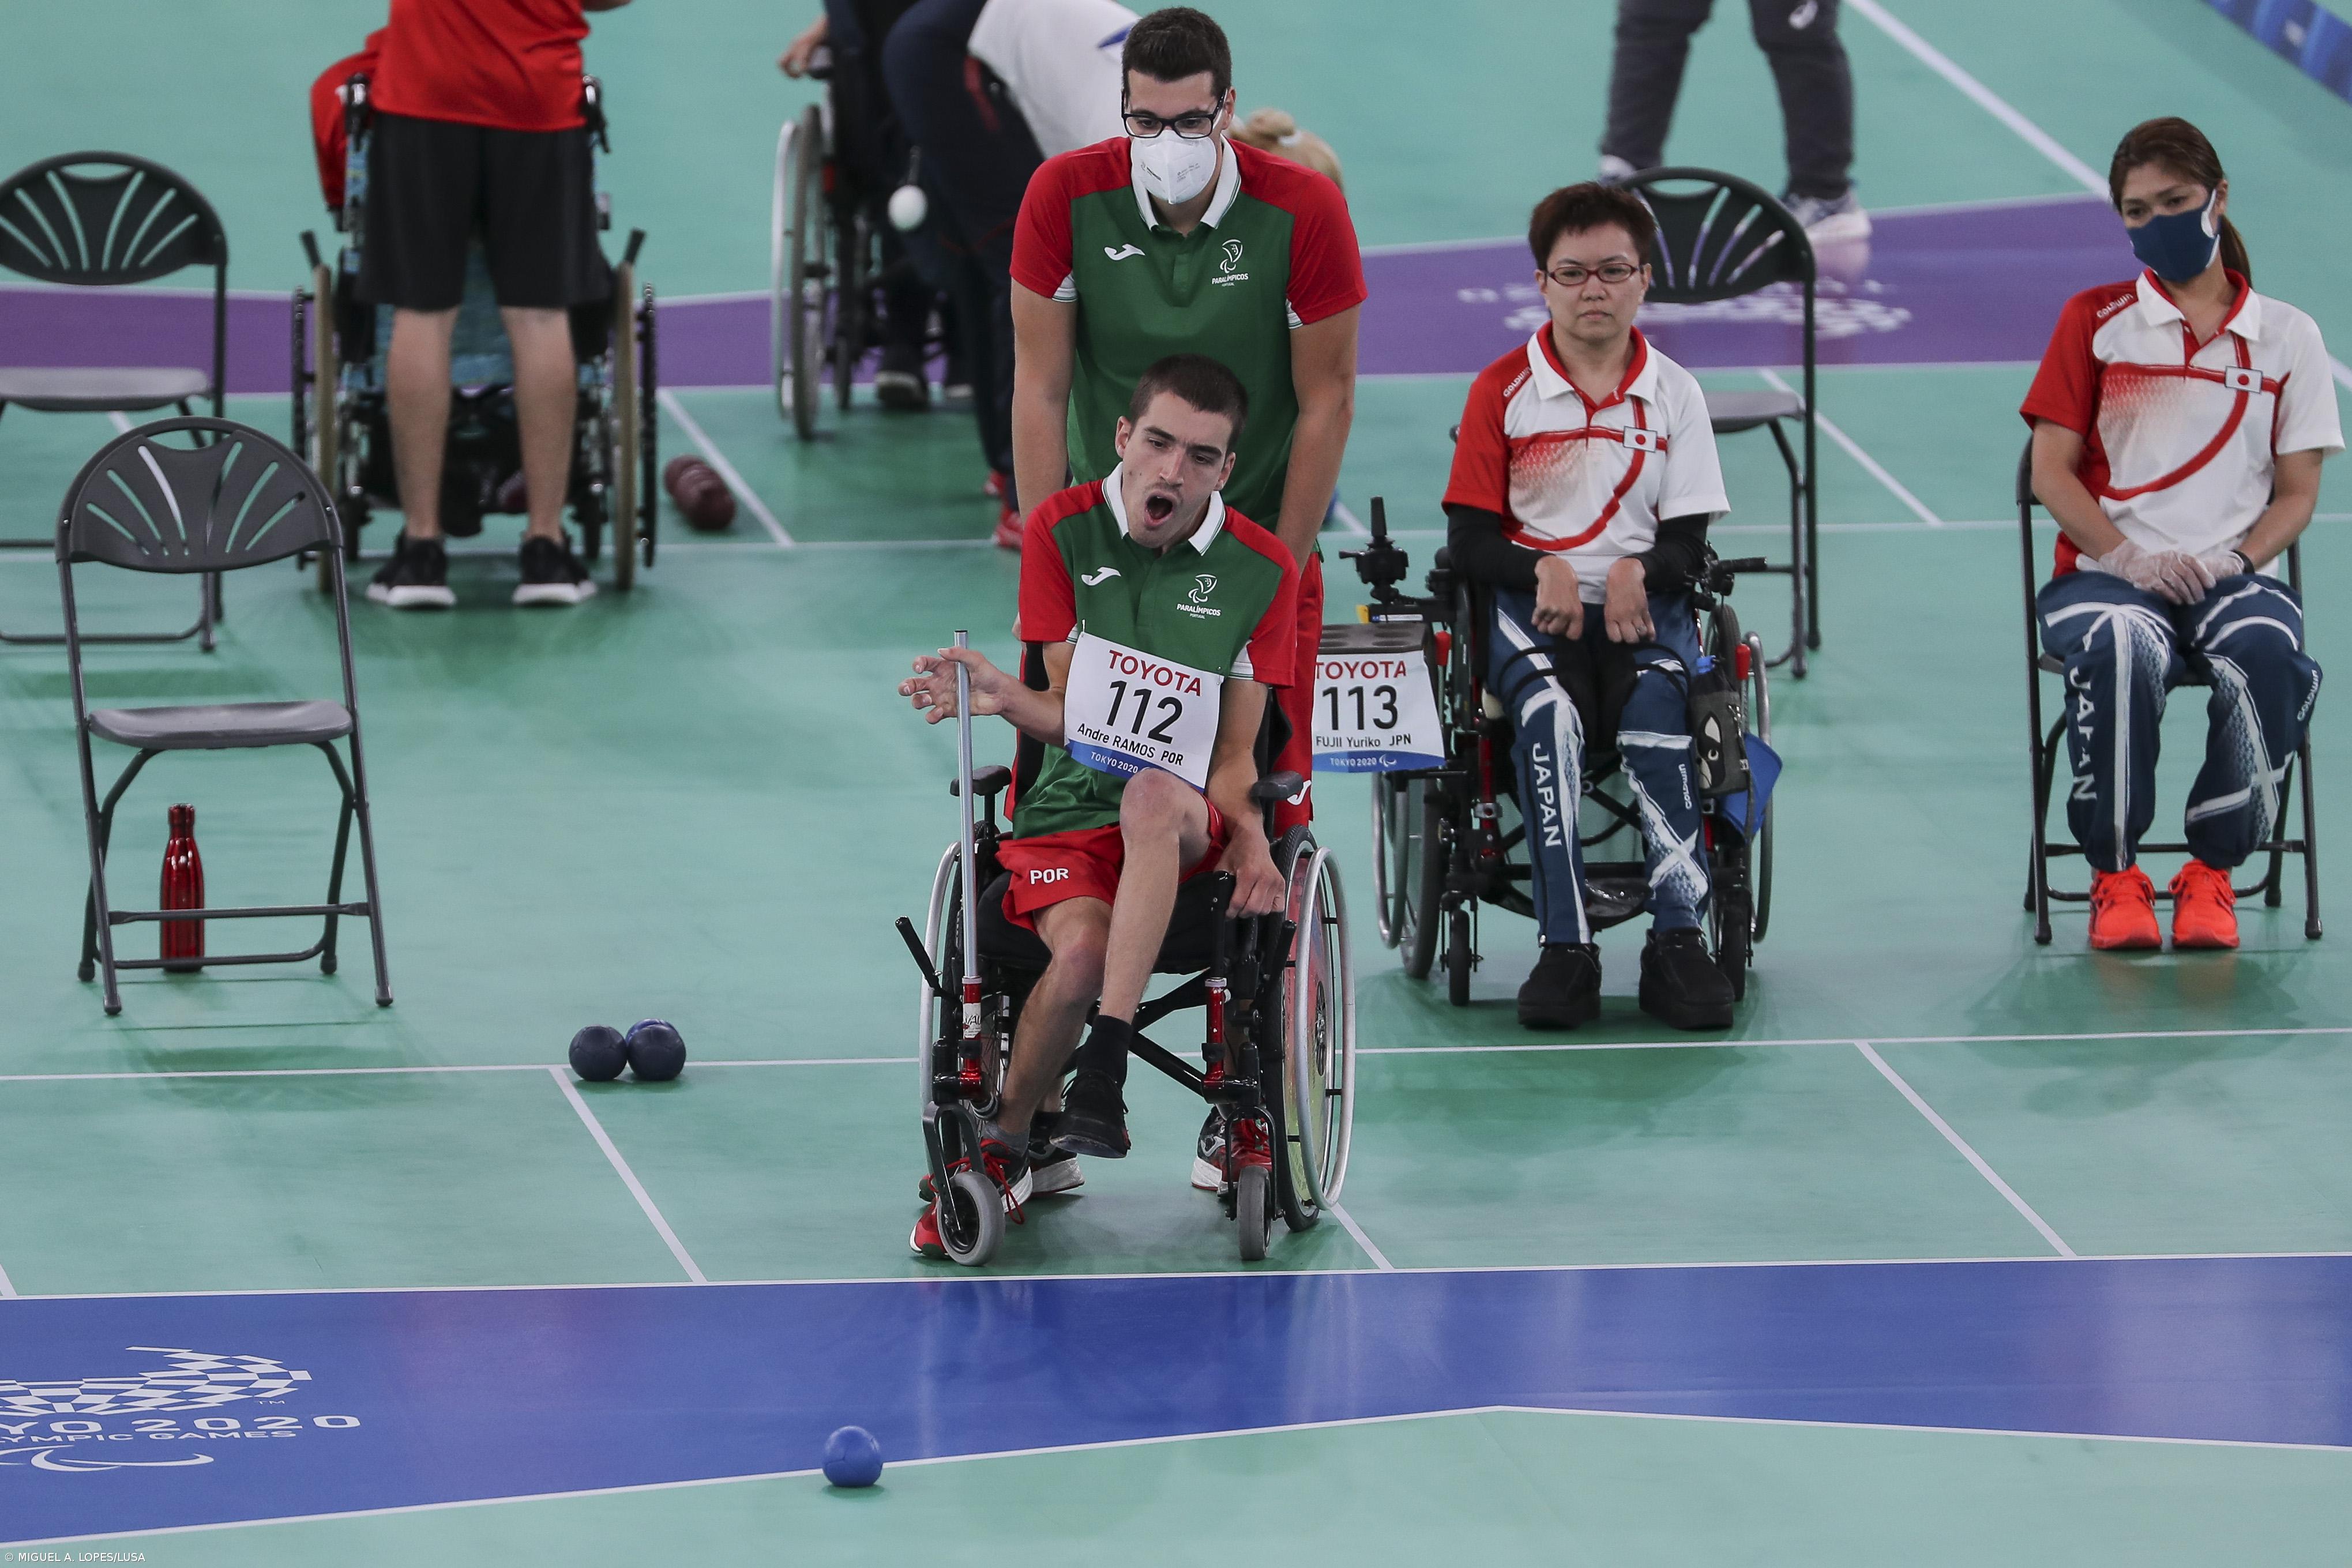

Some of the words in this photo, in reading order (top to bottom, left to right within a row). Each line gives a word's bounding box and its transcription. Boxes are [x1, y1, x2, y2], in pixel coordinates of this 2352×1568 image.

[1177, 603, 1222, 616] PARALÍMPICOS
[1109, 649, 1201, 697] TOYOTA
[1316, 660, 1407, 679] TOYOTA
[1106, 680, 1183, 744] 112
[1322, 685, 1398, 731] 113
[1077, 723, 1110, 743] Andre
[1112, 735, 1156, 758] RAMOS
[1160, 750, 1184, 766] POR
[1316, 735, 1342, 747] FUJII
[1346, 736, 1381, 747] Yuriko
[1389, 733, 1411, 746] JPN
[1091, 751, 1117, 767] TOKYO
[1118, 762, 1139, 774] 2020
[1330, 757, 1355, 766] TOKYO
[1357, 757, 1377, 766] 2020
[1532, 742, 1562, 847] JAPAN
[1030, 868, 1069, 885] POR
[131, 1415, 360, 1432] 2020
[0, 1433, 134, 1443] YMPIC
[149, 1431, 296, 1440] GAMES
